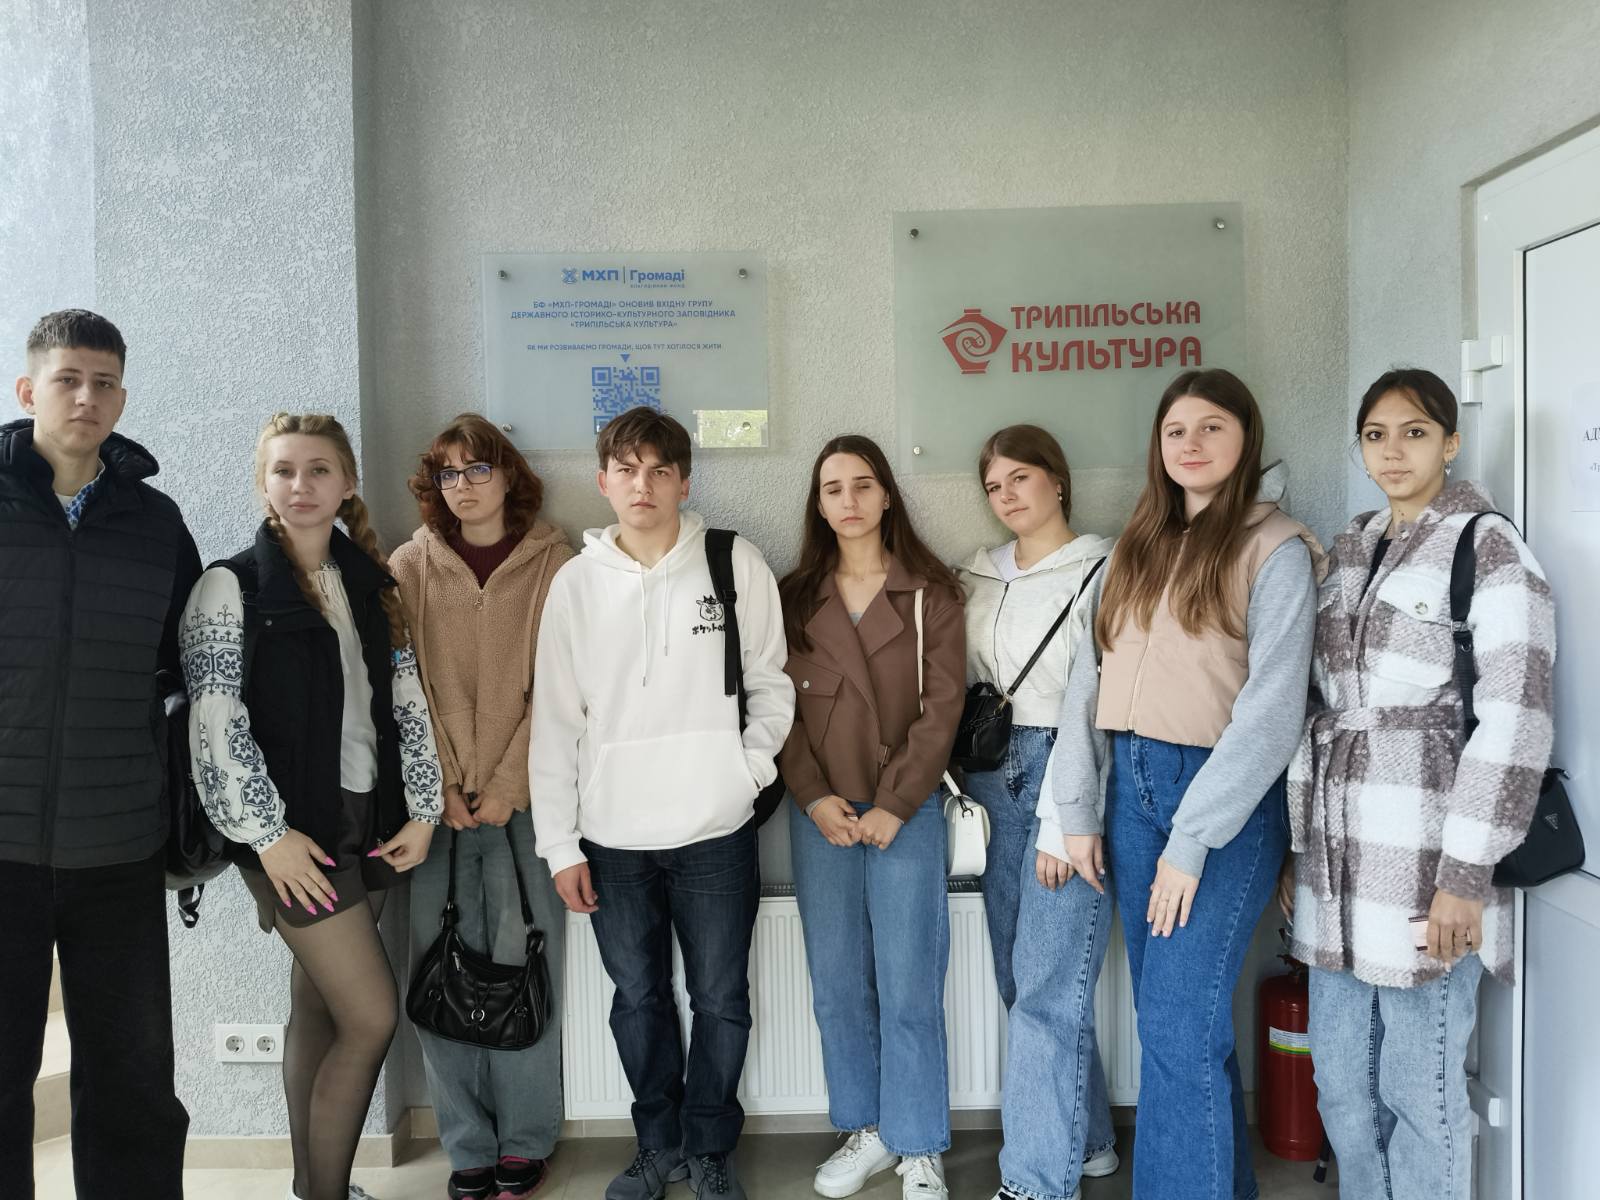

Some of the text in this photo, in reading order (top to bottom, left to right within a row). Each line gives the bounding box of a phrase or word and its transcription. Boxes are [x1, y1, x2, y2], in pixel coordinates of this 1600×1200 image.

[582, 269, 685, 283] МХП Громаді
[533, 301, 546, 309] БФ
[618, 300, 654, 308] ОНОВИВ
[656, 300, 686, 308] ВХІДНУ
[688, 300, 713, 308] ГРУПУ
[510, 311, 569, 319] ДЕРЖАВНОГО
[676, 310, 736, 318] ЗАПОВІДНИКА
[1010, 301, 1201, 330] ТРИПІЛЬСЬКА
[1011, 336, 1202, 373] КУЛЬТУРА
[1583, 427, 1600, 441] АД
